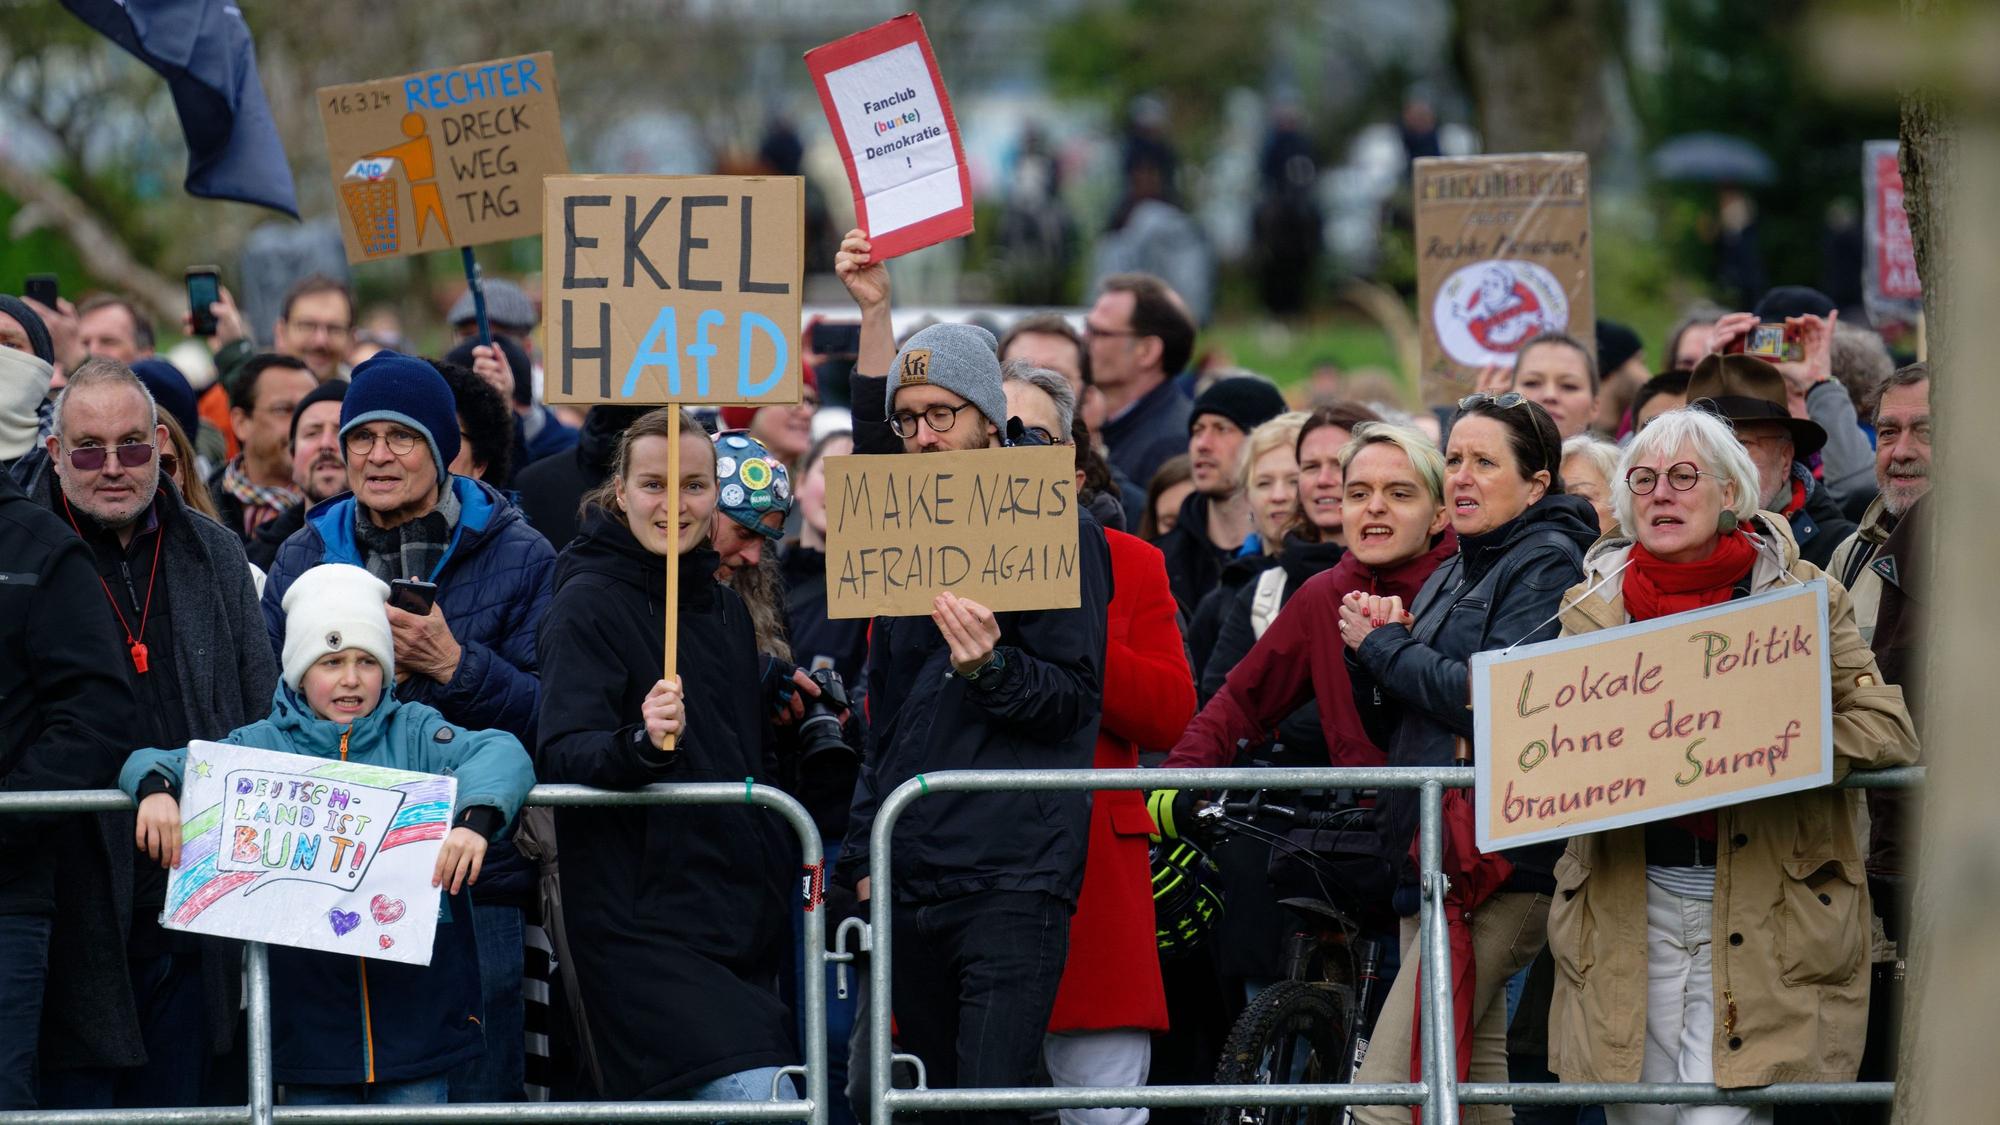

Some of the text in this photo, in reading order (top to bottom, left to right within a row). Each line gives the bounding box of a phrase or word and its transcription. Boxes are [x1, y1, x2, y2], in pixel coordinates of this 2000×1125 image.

[403, 58, 542, 113] RECHTER
[863, 87, 917, 115] Fanclub
[441, 104, 531, 146] DRECK
[865, 125, 941, 161] Demokratie
[874, 108, 921, 137] (bunte)
[449, 145, 518, 182] WEG
[456, 185, 520, 223] TAG
[562, 195, 789, 294] EKEL
[838, 471, 954, 533] MAKE
[838, 543, 1077, 599] AFRAID AGAIN
[1516, 625, 1813, 718] Lokale Politik
[1649, 700, 1721, 742] den
[1501, 720, 1801, 823] braunen Sumpf
[236, 777, 361, 811] DEUTSCH-
[234, 799, 372, 836] LAND IST
[230, 825, 367, 879] BUNT!
